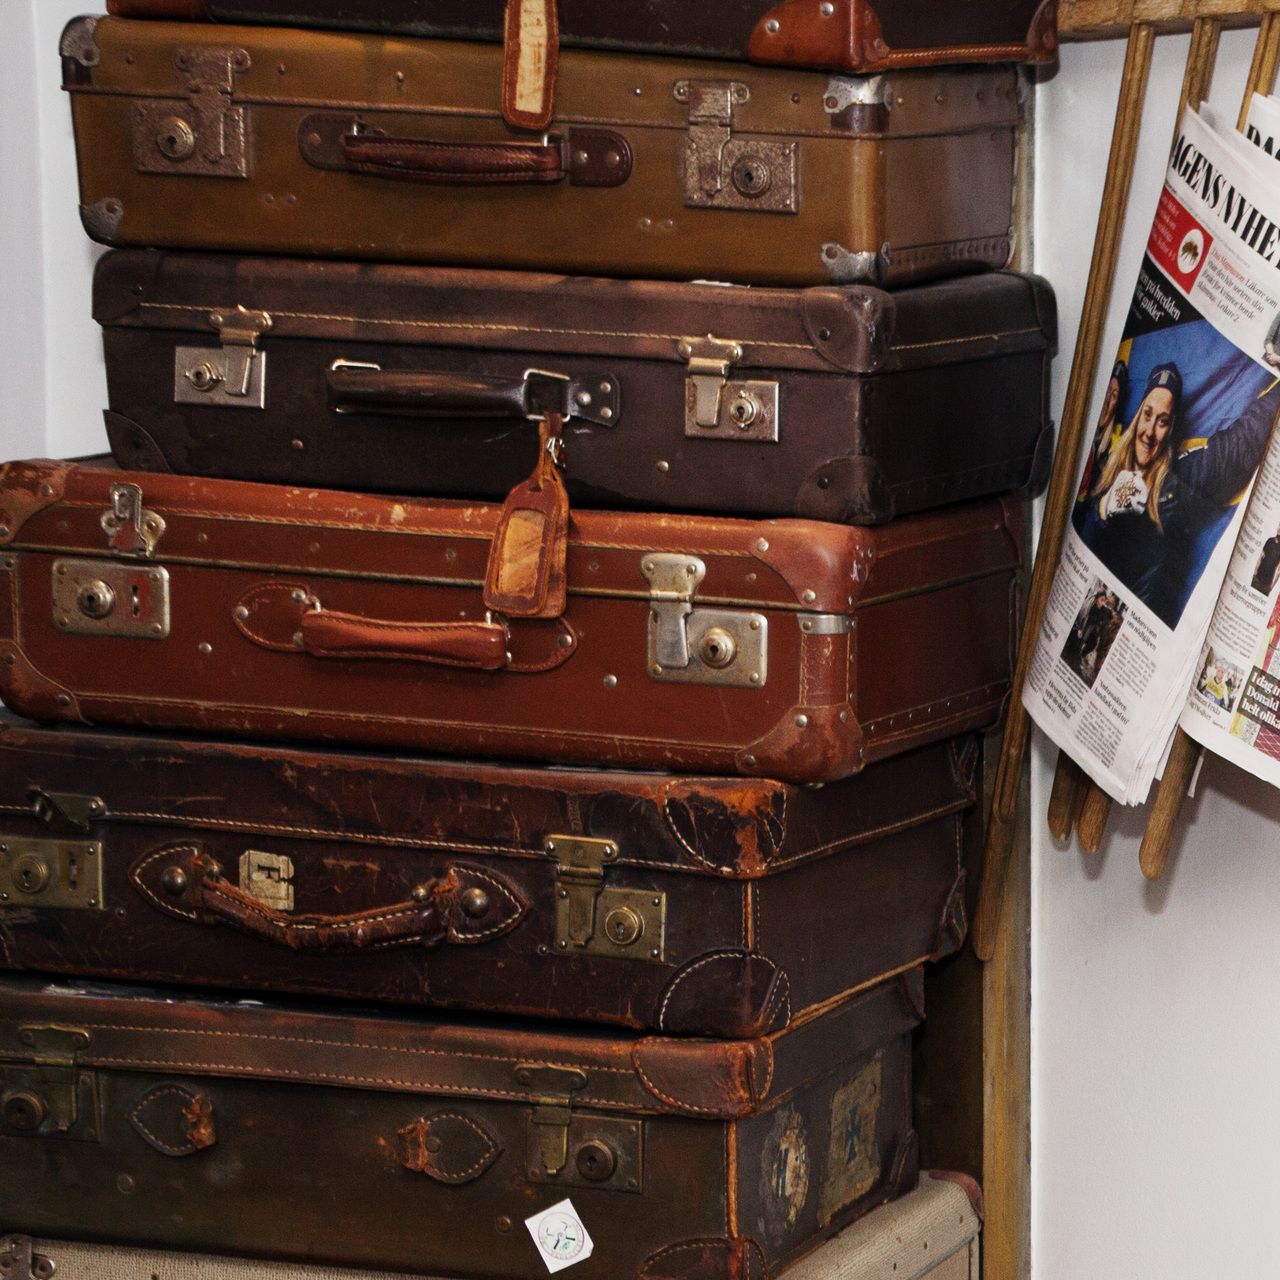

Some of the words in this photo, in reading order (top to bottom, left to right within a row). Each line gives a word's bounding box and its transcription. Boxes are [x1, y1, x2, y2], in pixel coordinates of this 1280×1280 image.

[1256, 675, 1274, 694] dag
[1241, 698, 1260, 717] helt
[1246, 686, 1280, 711] Donald
